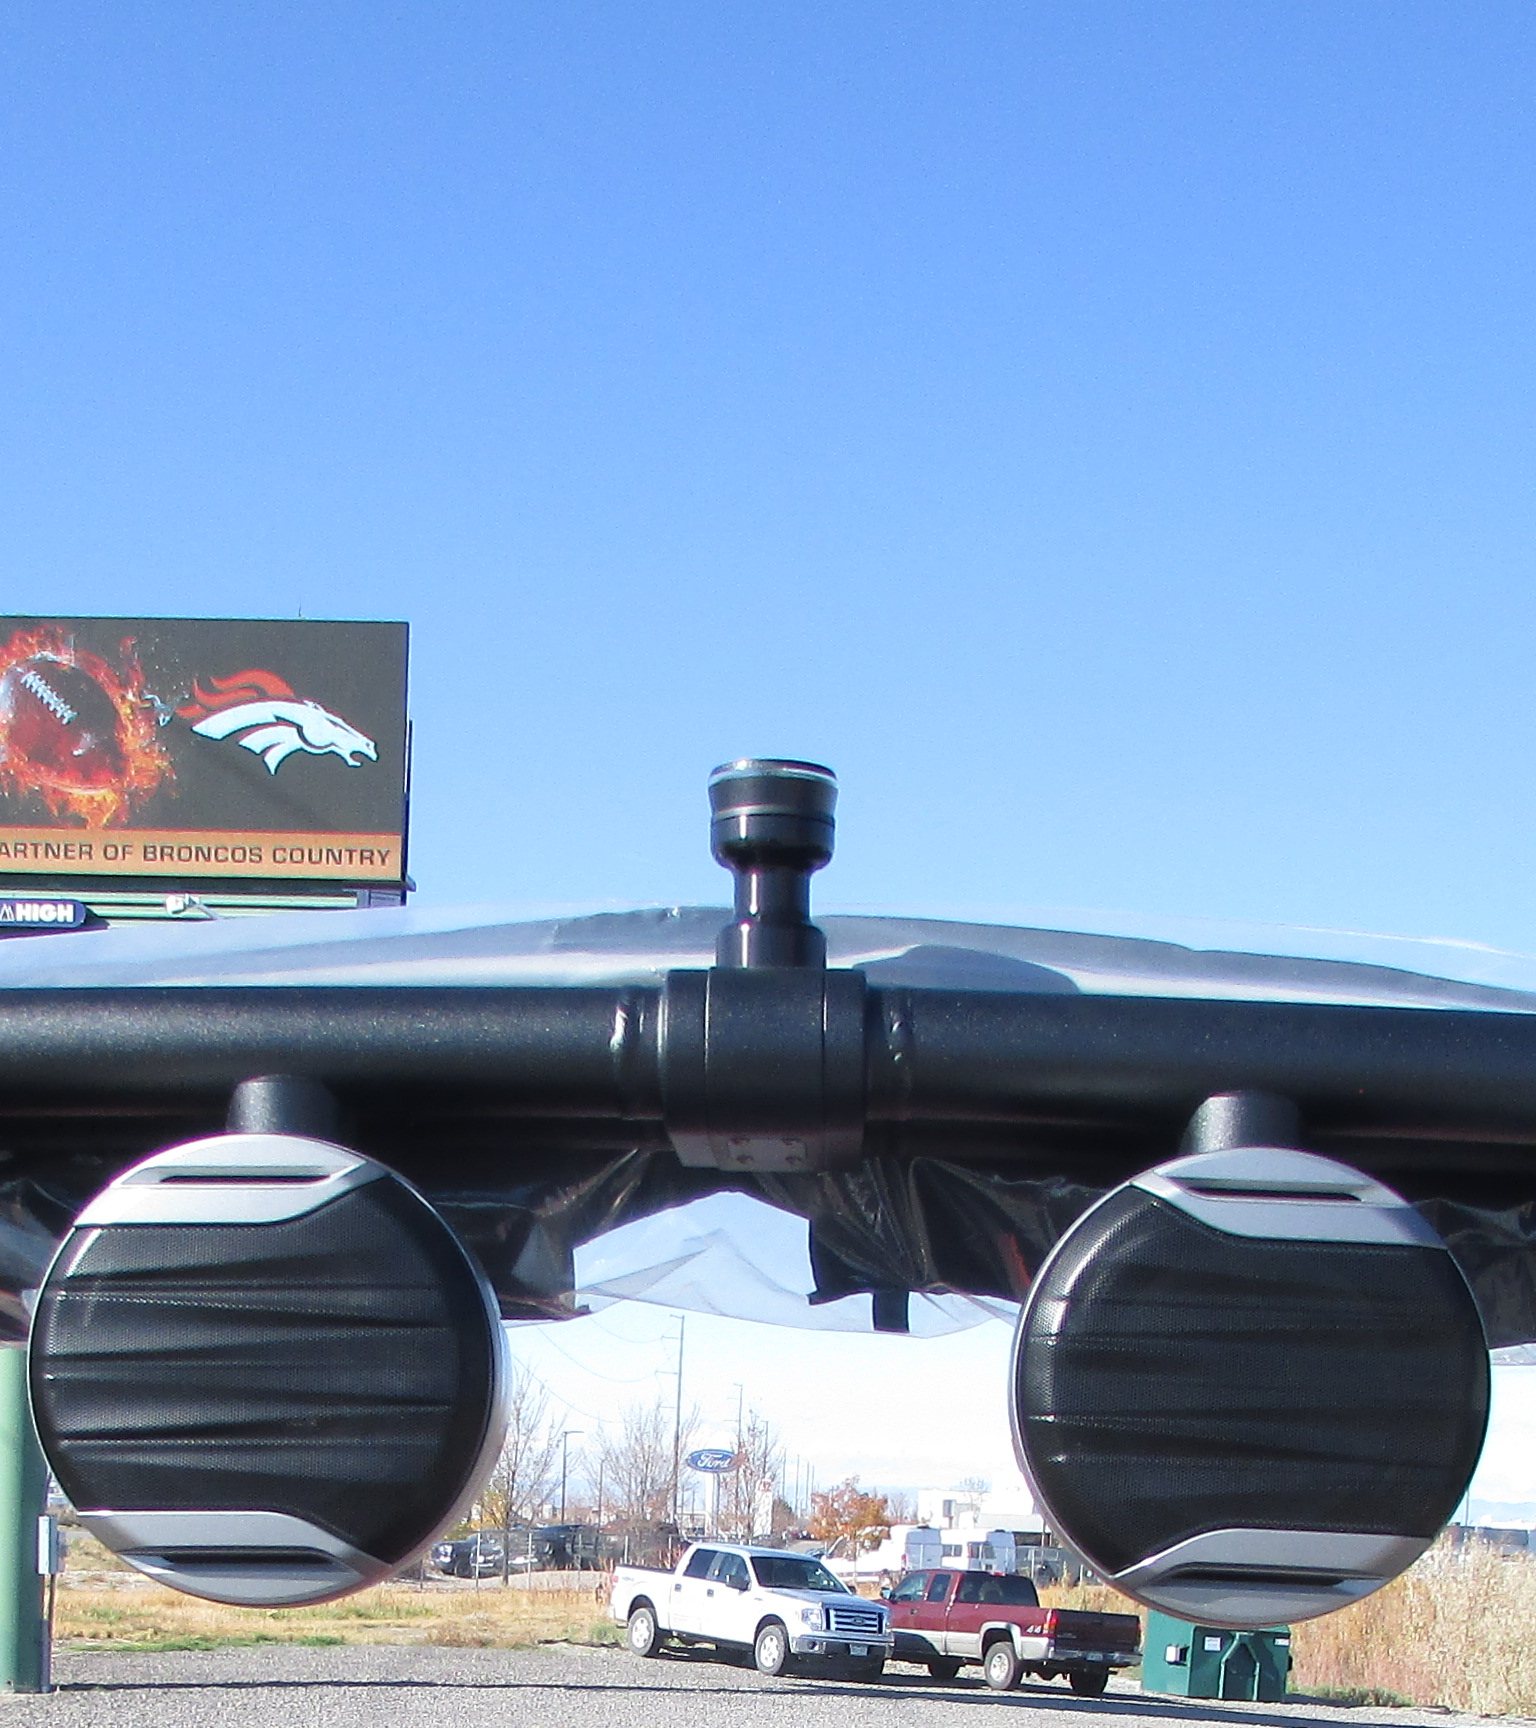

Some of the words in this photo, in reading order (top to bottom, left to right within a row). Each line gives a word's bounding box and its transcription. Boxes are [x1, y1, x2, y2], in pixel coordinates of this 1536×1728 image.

[102, 843, 134, 861] OF
[143, 845, 263, 864] BRONCOS
[272, 846, 391, 867] COUNTRY
[15, 902, 74, 923] HIGH
[697, 1454, 732, 1468] Ford
